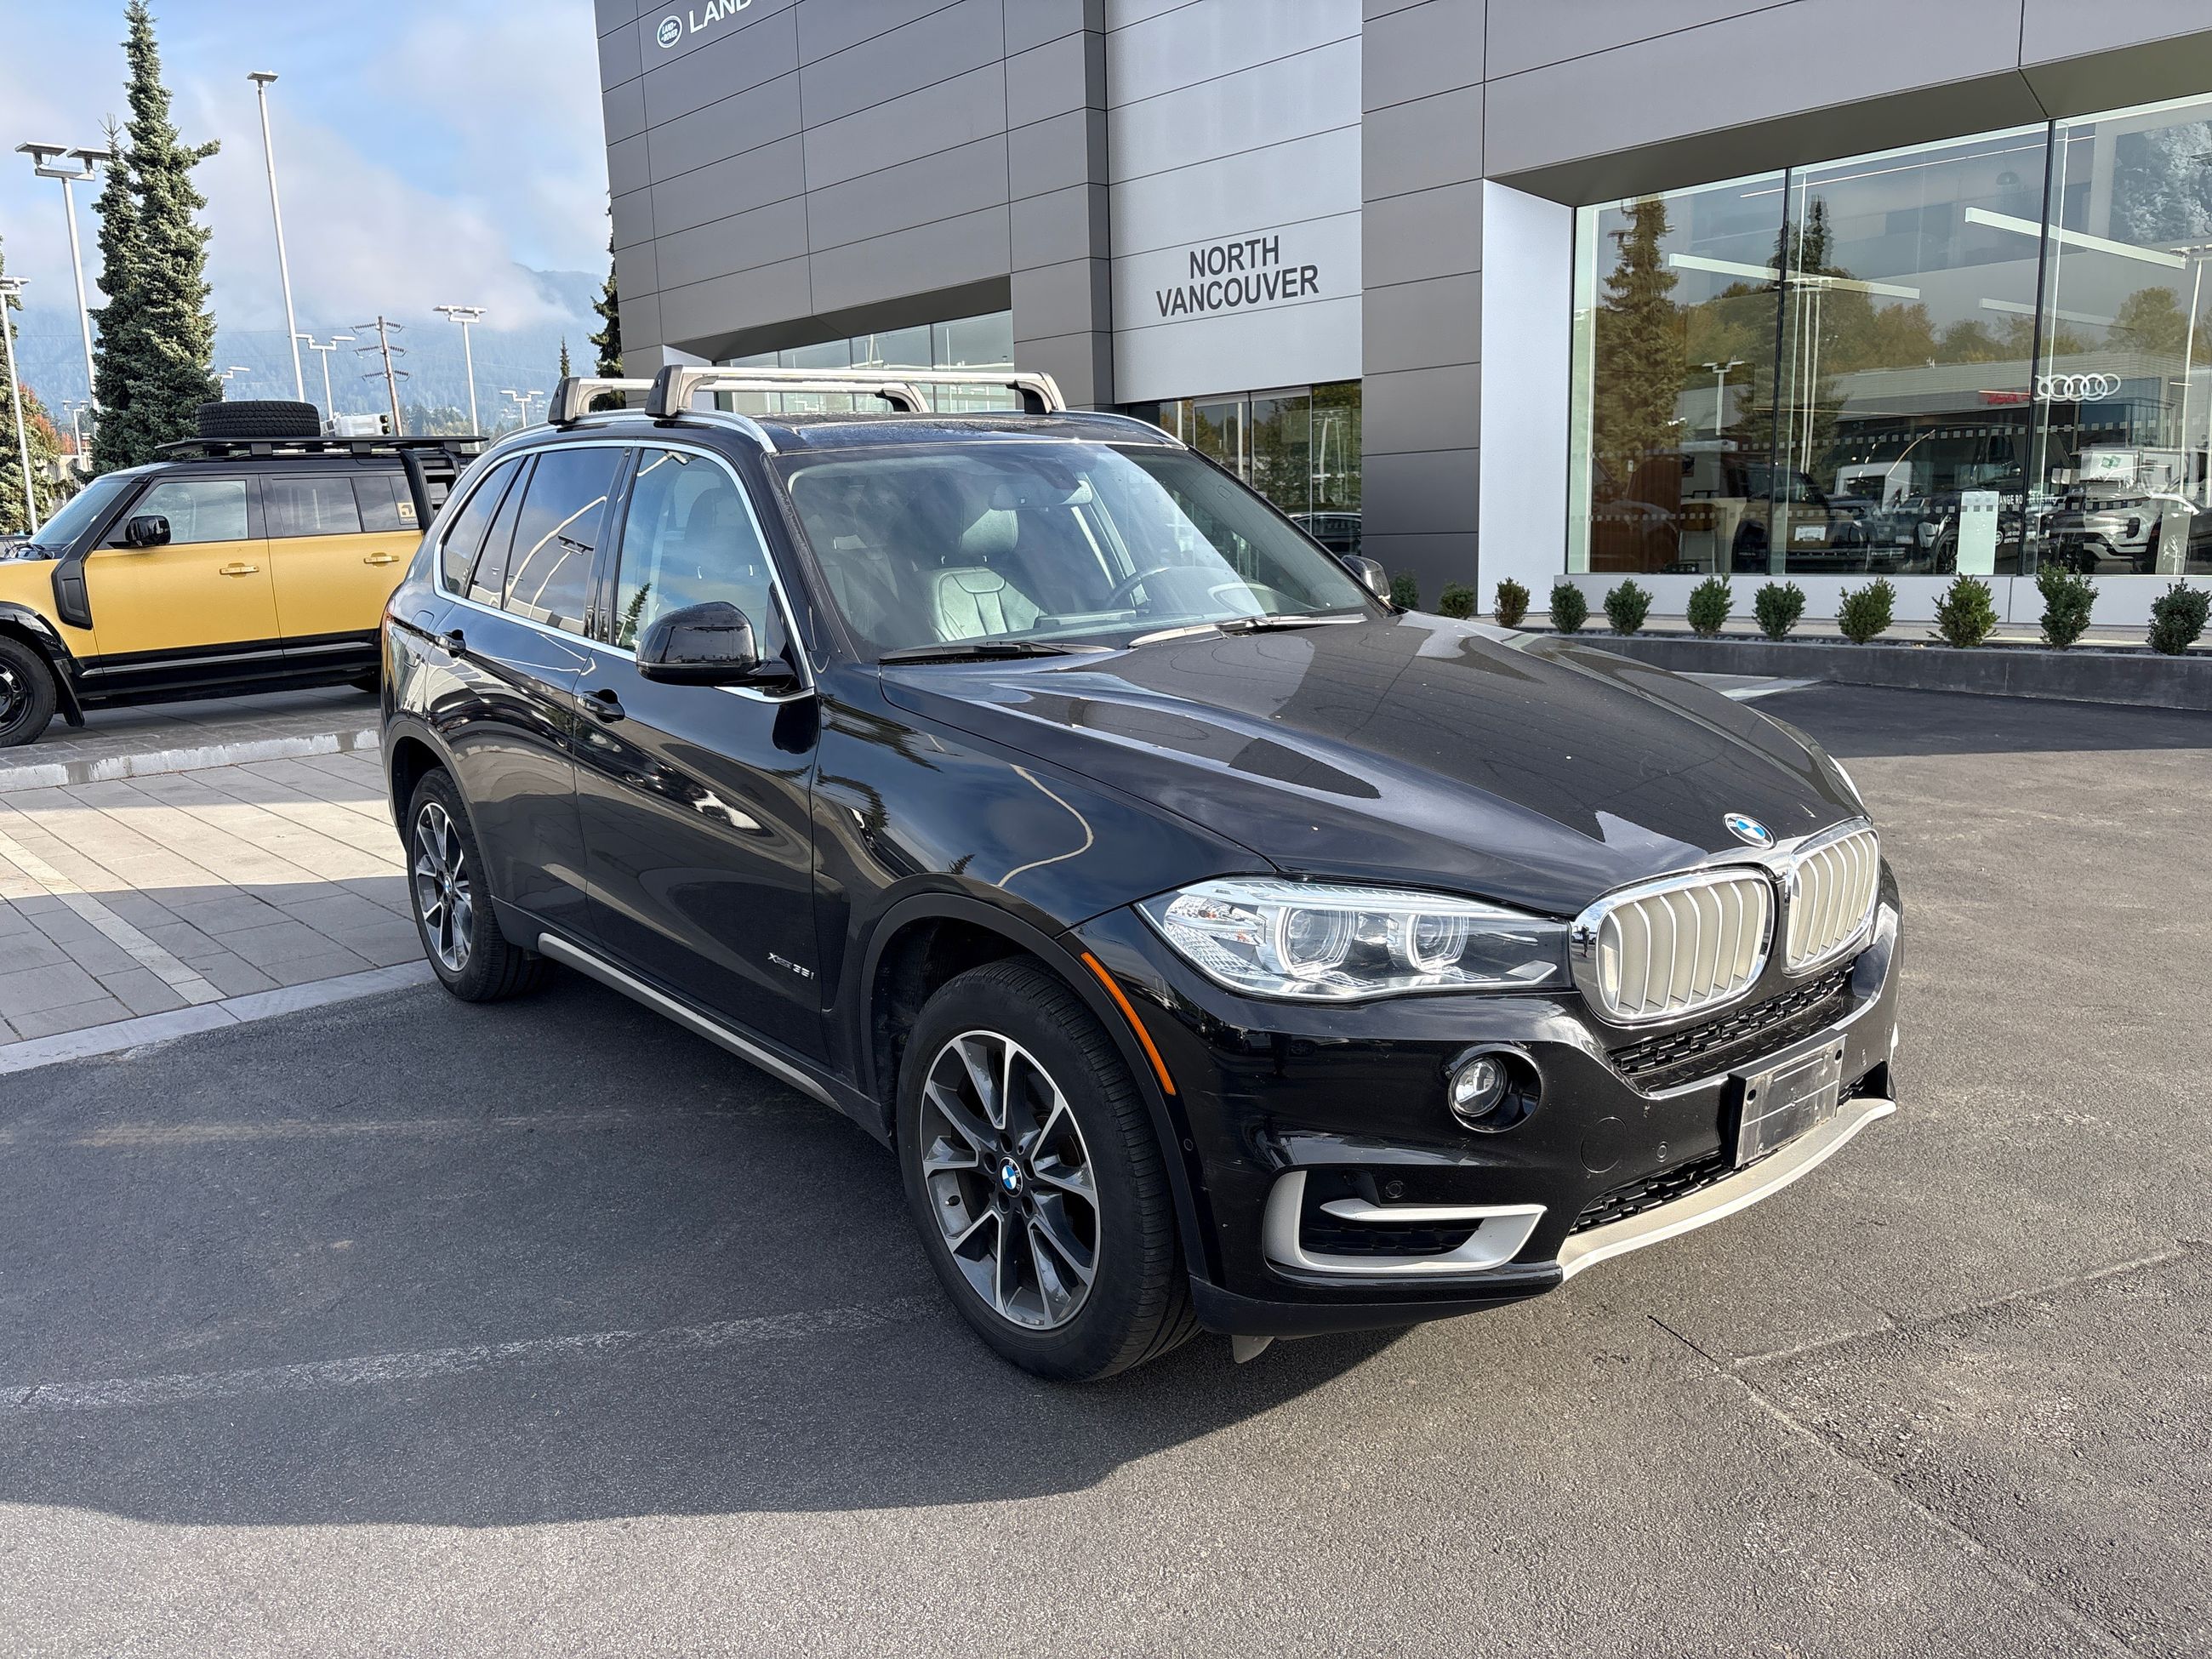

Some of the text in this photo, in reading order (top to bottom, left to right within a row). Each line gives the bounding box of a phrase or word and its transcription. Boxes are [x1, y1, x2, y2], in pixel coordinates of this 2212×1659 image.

[661, 21, 675, 35] LAND
[663, 28, 678, 43] ROVER
[1189, 235, 1280, 279] NORTH
[1155, 264, 1320, 317] VANCOUVER
[1998, 494, 2015, 505] ANGE
